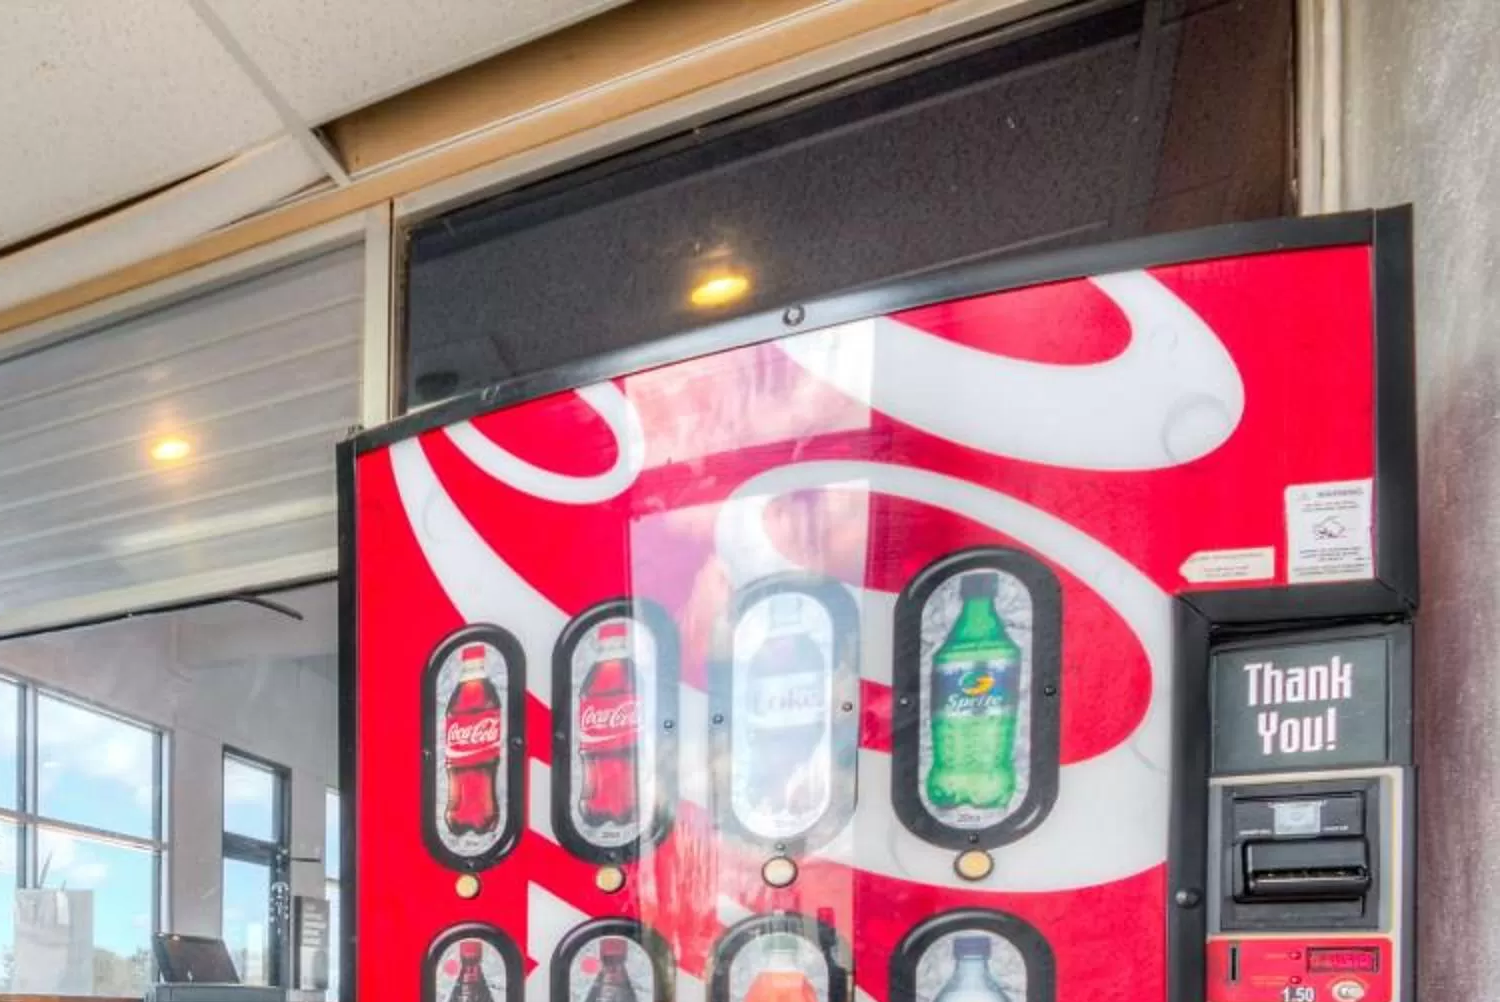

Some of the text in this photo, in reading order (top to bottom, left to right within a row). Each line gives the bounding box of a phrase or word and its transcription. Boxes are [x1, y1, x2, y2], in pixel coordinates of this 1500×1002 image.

[1243, 655, 1354, 707] Thank
[944, 691, 1003, 718] Sprite
[446, 715, 499, 744] Coca-Cola
[1257, 706, 1338, 756] You!
